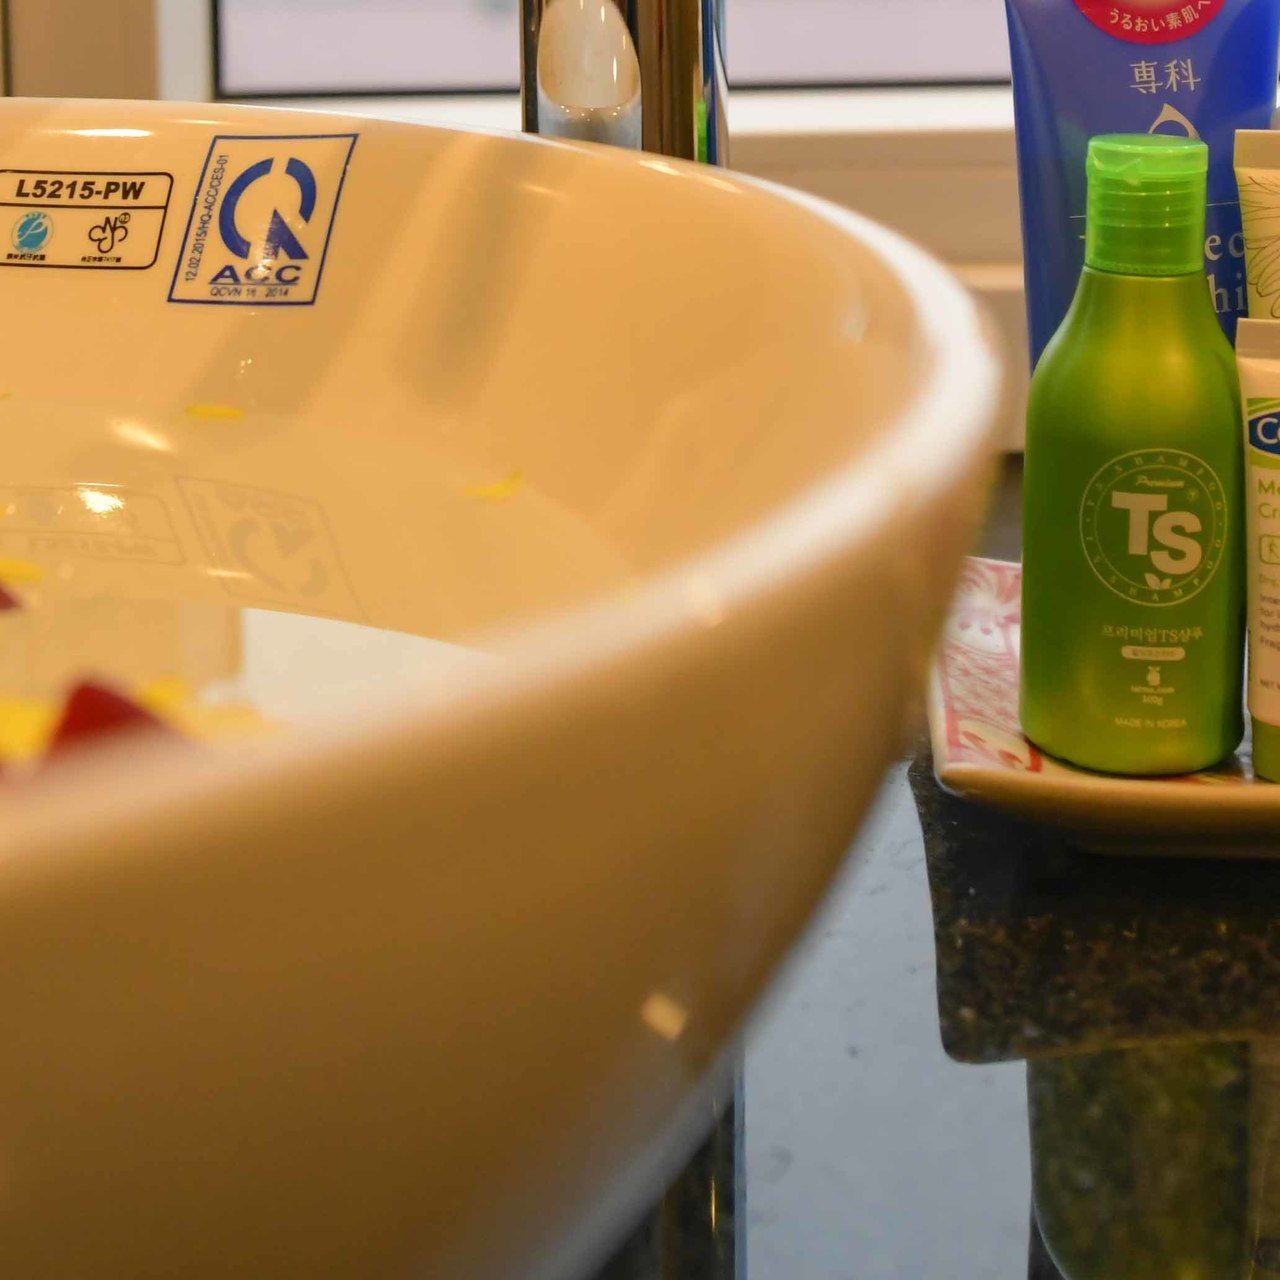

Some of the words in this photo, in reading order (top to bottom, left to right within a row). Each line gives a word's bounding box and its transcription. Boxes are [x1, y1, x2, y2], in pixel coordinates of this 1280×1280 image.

[1109, 0, 1212, 32] うるおい素肌へ
[1129, 58, 1202, 94] 専科
[14, 179, 146, 201] L5215-PW
[209, 264, 303, 284] ACC
[210, 286, 242, 297] QCVN
[1111, 491, 1202, 575] TS
